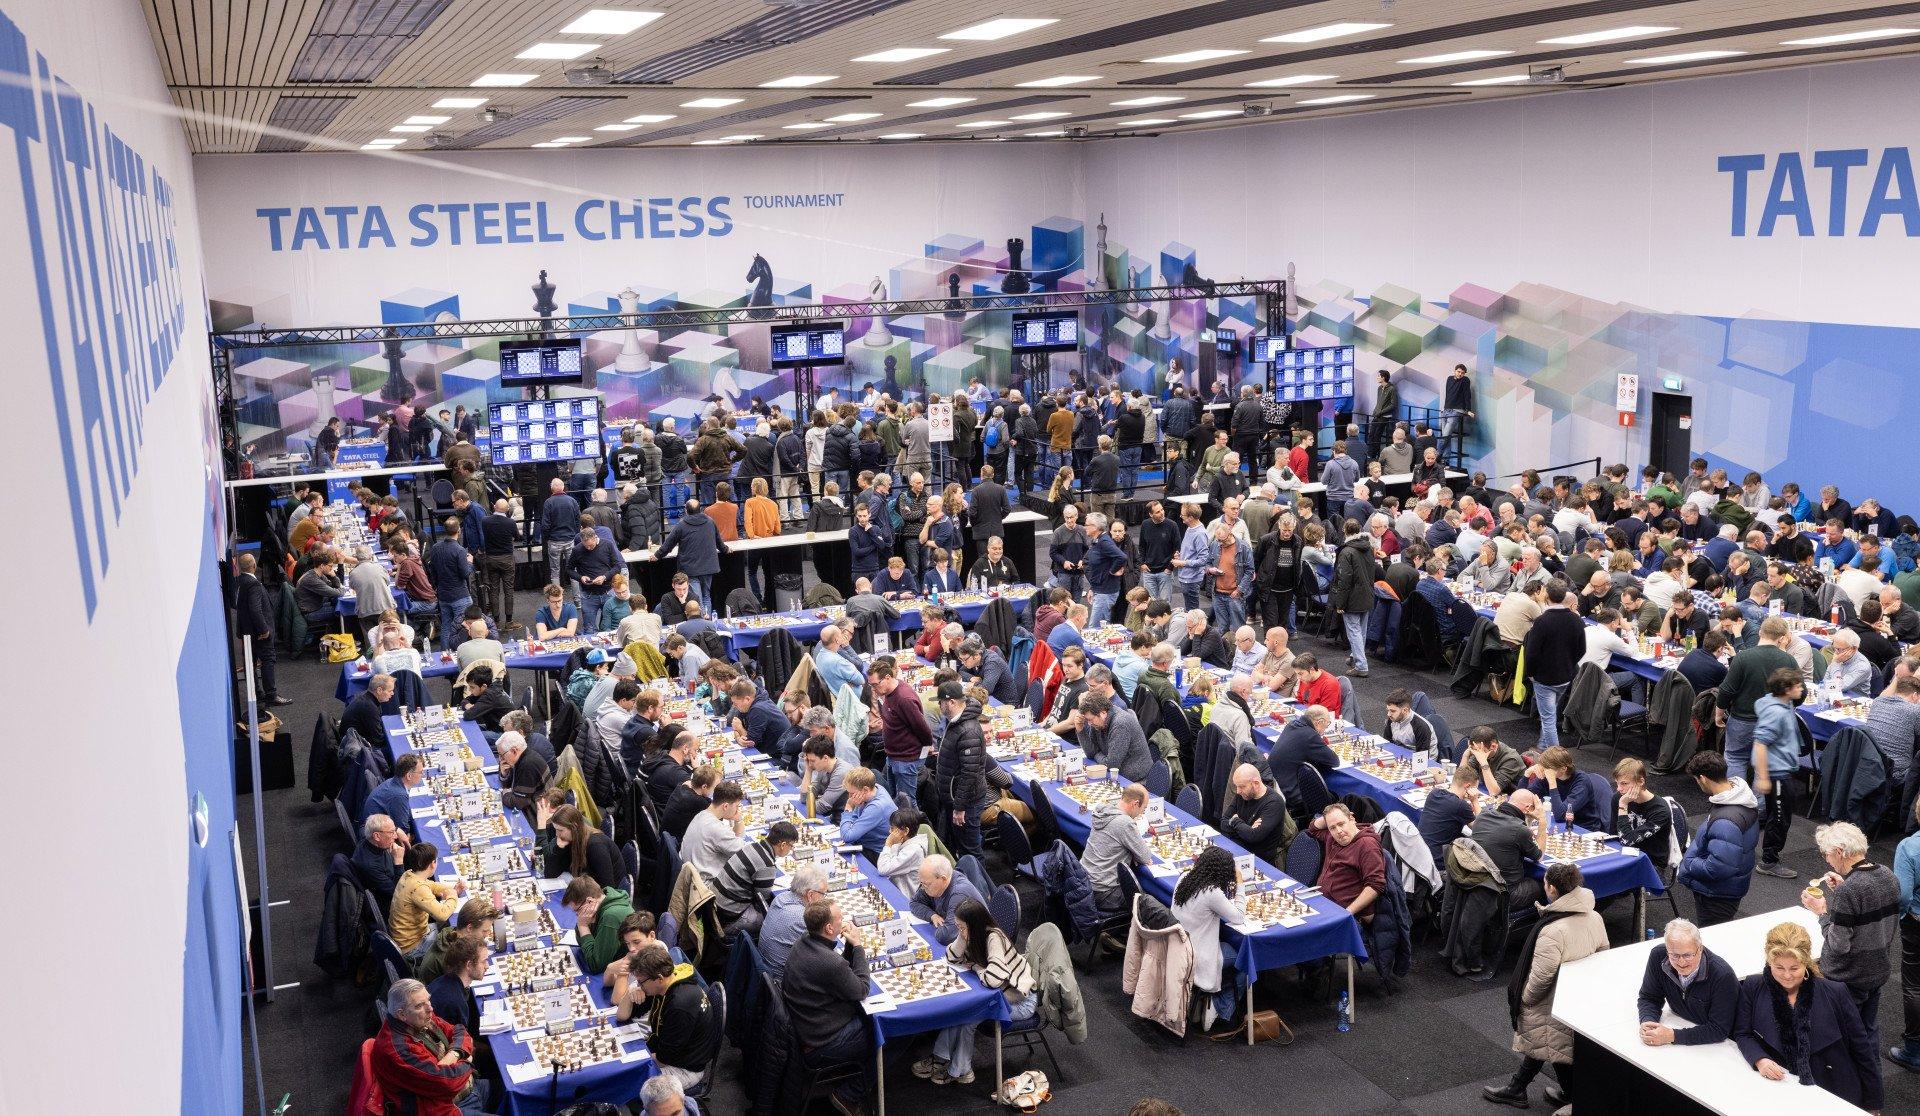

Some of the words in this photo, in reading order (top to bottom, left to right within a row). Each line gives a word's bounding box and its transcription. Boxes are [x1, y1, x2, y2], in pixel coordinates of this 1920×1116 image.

[1718, 146, 1920, 237] TATA
[744, 193, 845, 209] TOURNAMENT
[256, 205, 396, 251] TATA
[408, 201, 565, 247] STEEL
[574, 196, 733, 241] CHESS
[362, 452, 380, 460] STEEL
[551, 1000, 562, 1008] 7L
